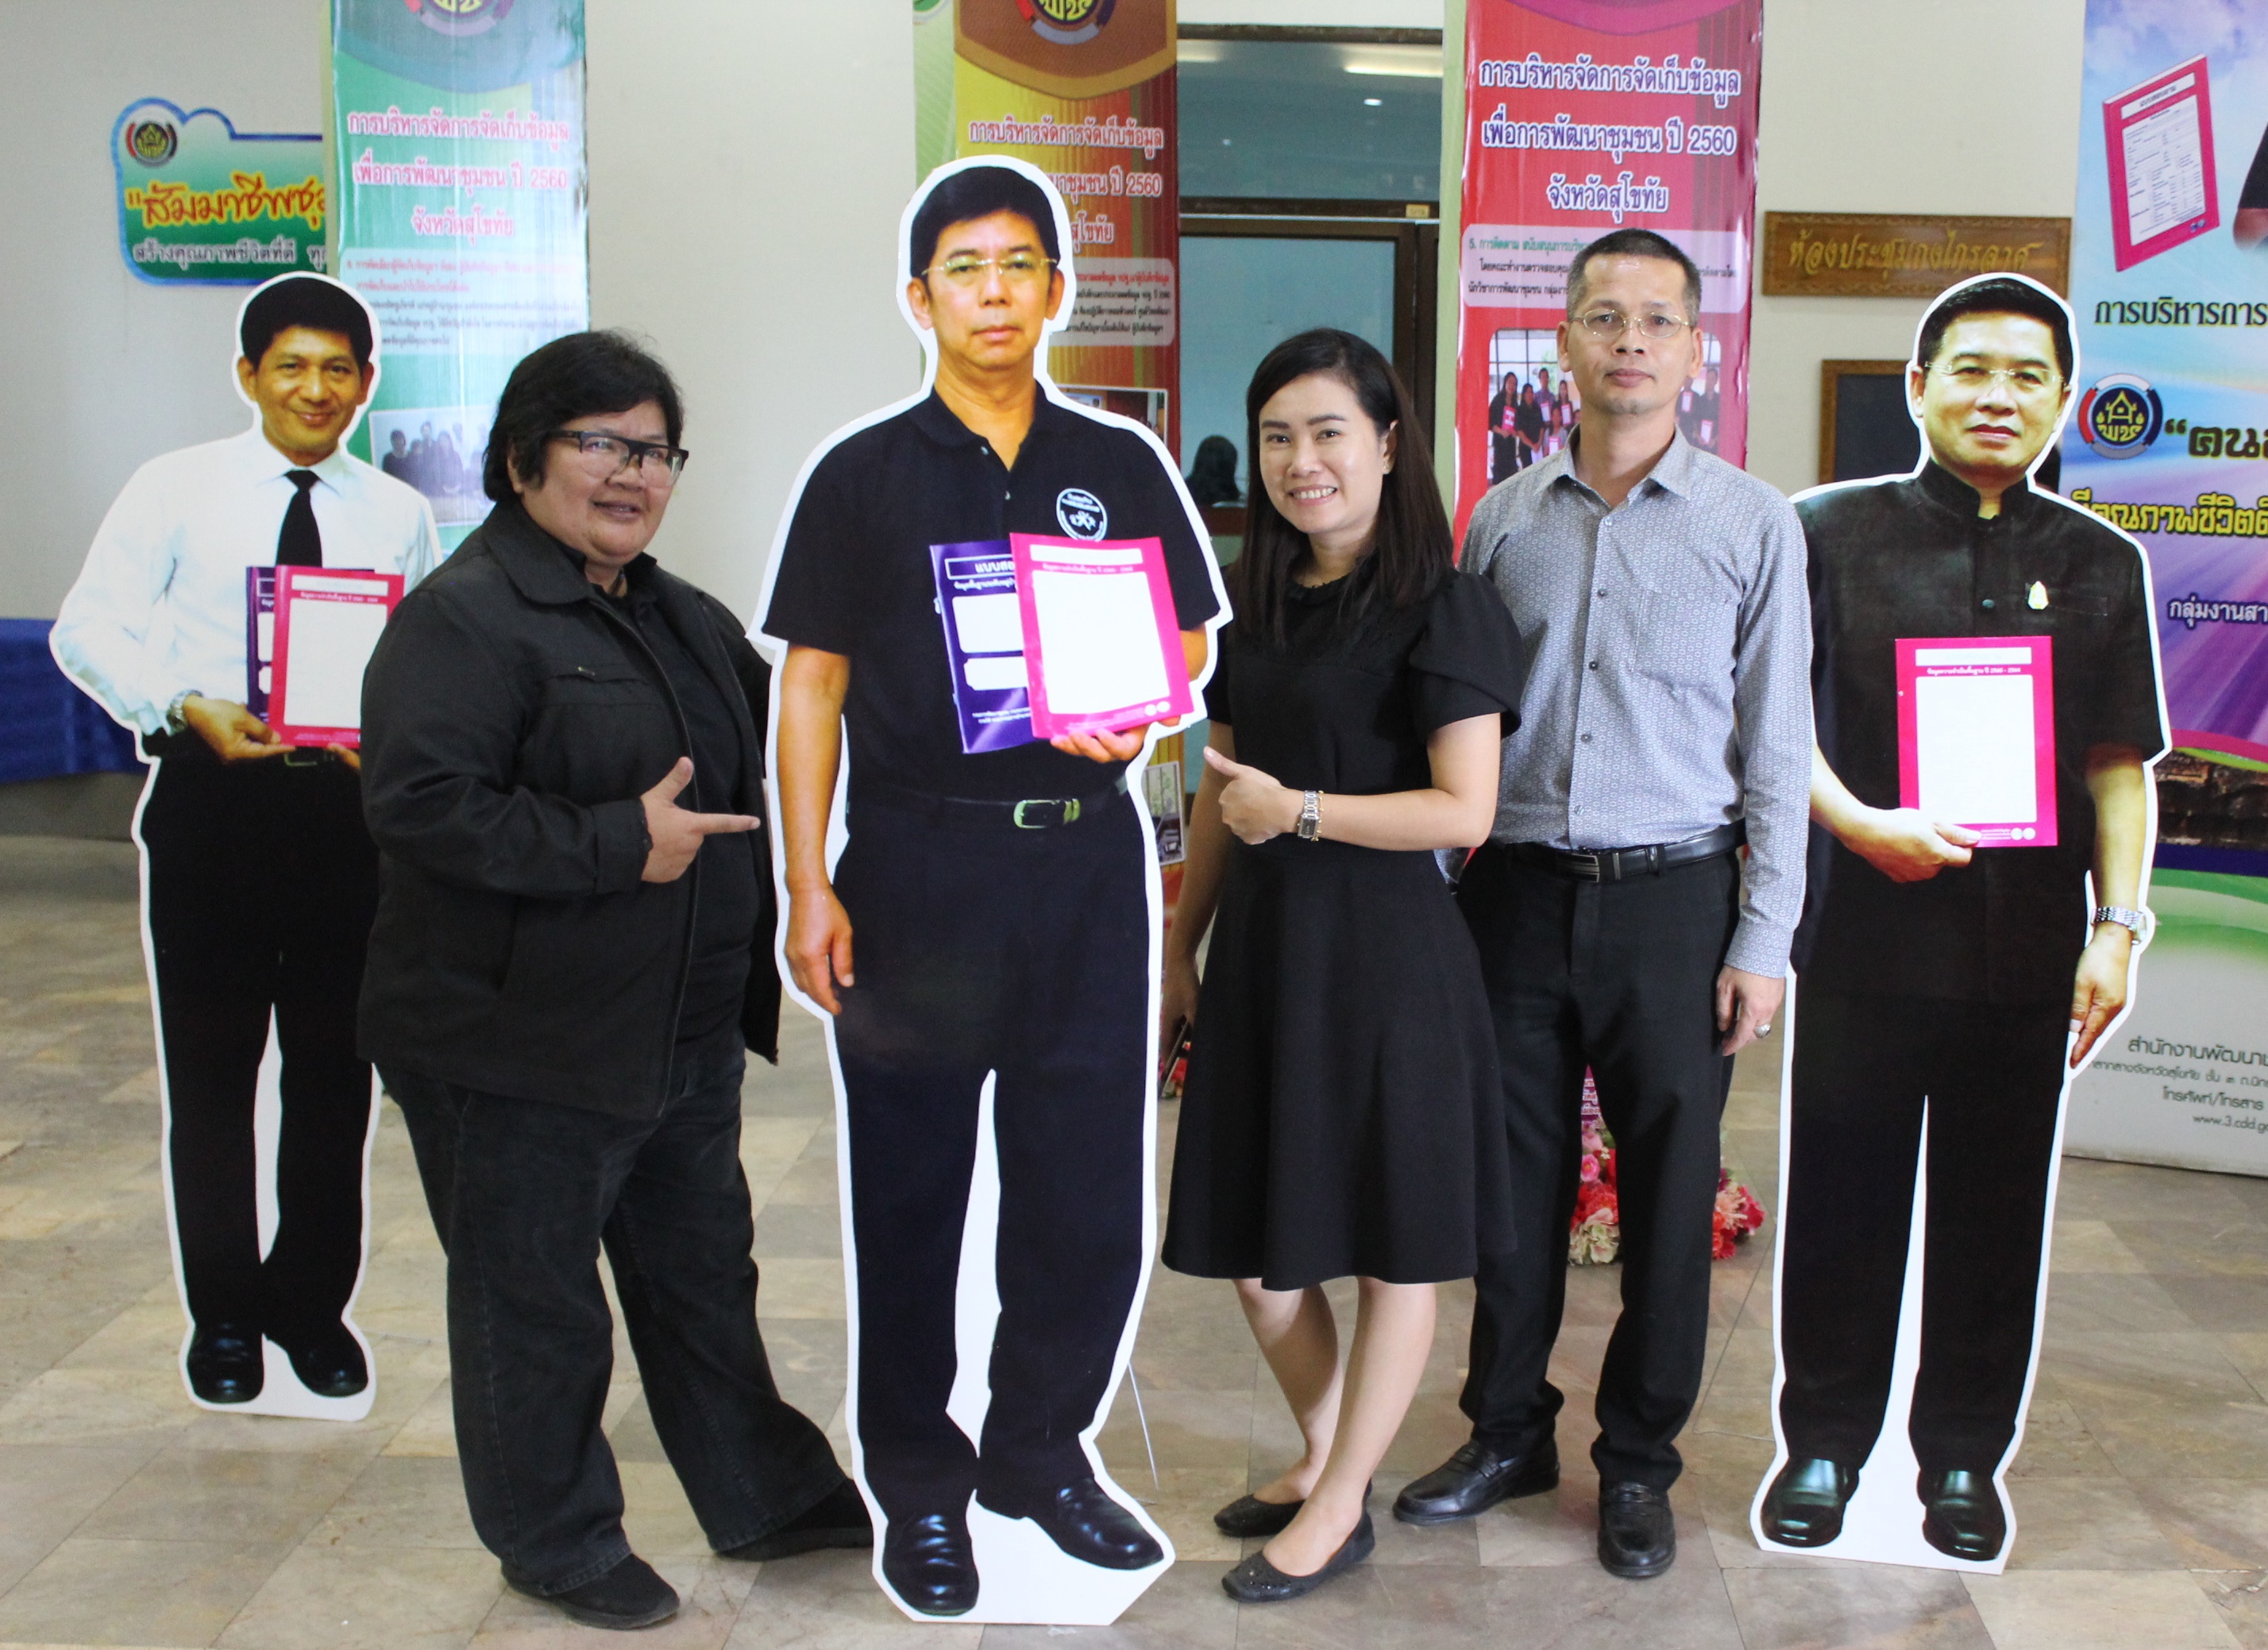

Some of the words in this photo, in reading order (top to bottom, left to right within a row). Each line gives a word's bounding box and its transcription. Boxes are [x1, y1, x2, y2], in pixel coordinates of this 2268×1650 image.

[1480, 52, 1741, 108] การบริหารจัดการจัดเก็บข้อมูล
[348, 106, 569, 152] การบริหารจัดการจัดเก็บข้อมูล
[969, 114, 1164, 158] การบริหารจัดการจัดเก็บข้อมูล
[1482, 105, 1662, 164] เพื่อการพัฒนาชุมชน
[1666, 120, 1682, 153] ปี
[1688, 125, 1737, 156] 2560
[352, 148, 507, 197] เพื่อการพัฒนาชุมชน
[511, 160, 525, 188] ปี
[528, 168, 569, 189] 2560
[1109, 165, 1124, 196] ปี
[1126, 172, 1163, 197] 2560
[1546, 172, 1668, 224] จังหวัดสุโขทัย
[411, 205, 515, 247] จังหวัดสุโขทัย
